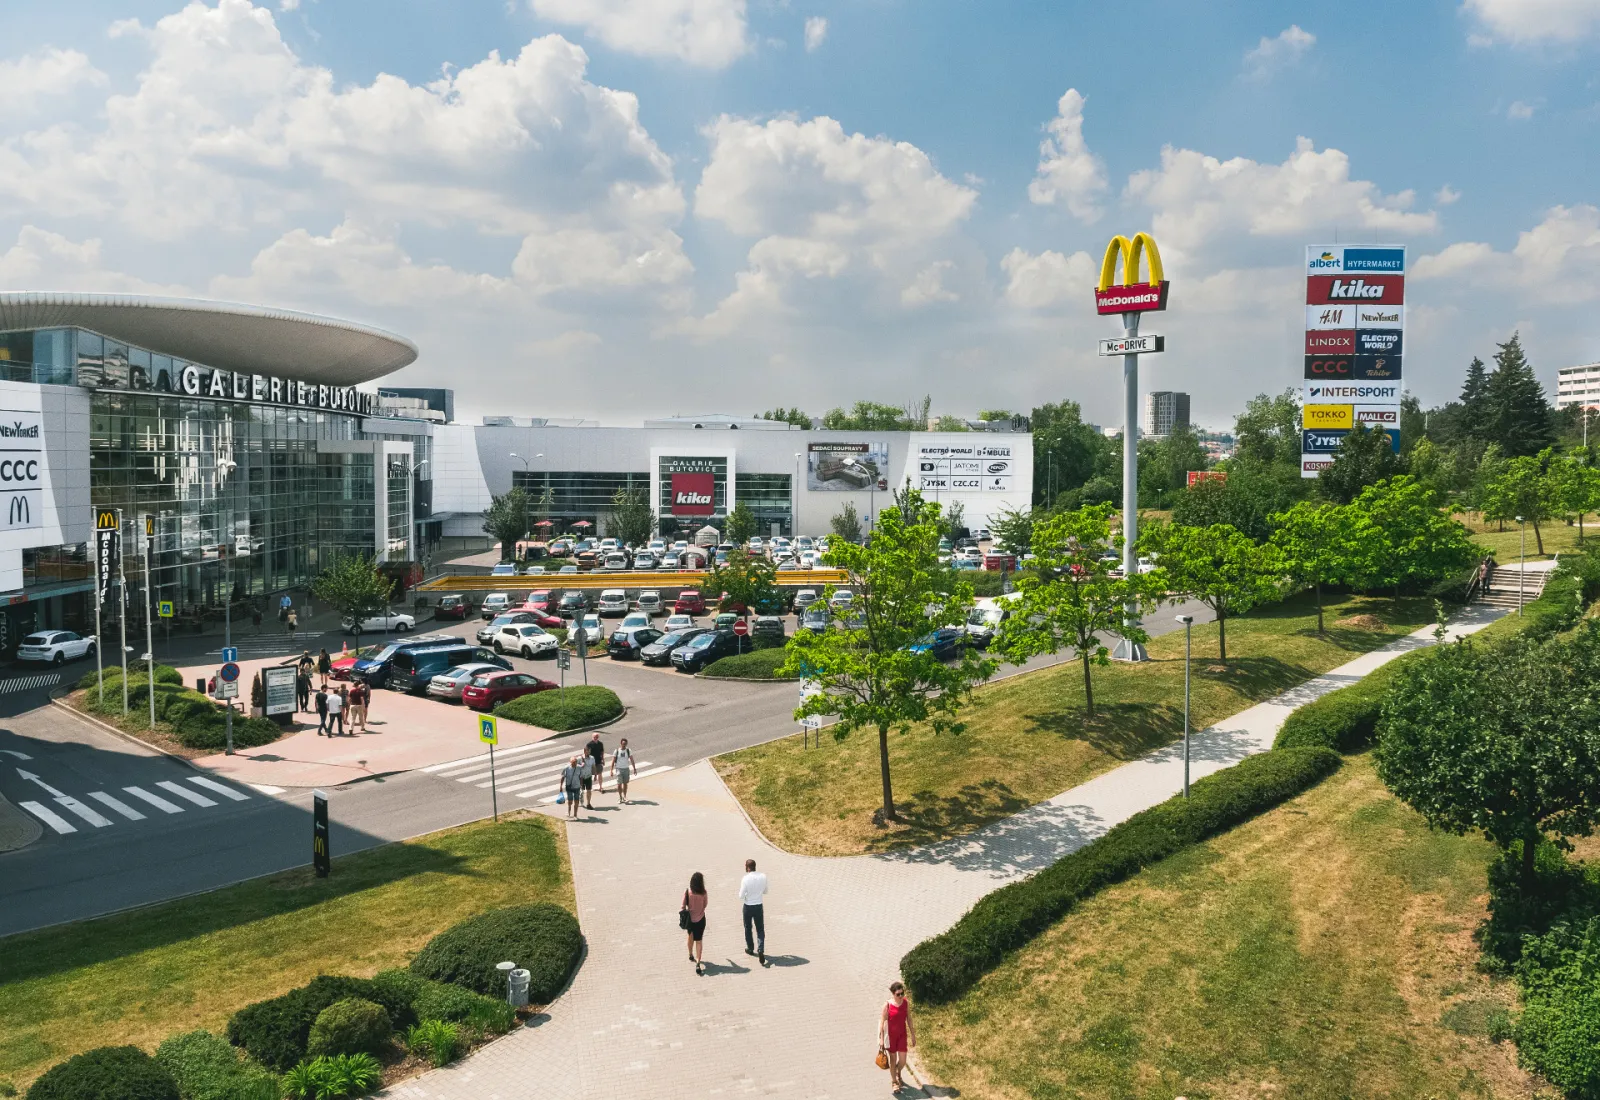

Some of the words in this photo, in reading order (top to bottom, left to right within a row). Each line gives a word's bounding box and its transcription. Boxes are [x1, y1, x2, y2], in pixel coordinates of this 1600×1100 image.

[1310, 259, 1341, 268] albert
[1347, 260, 1401, 268] HYPERMARKET
[1331, 280, 1385, 298] kika
[1098, 293, 1159, 307] McDonald's
[1319, 309, 1343, 325] H&M
[1309, 338, 1350, 346] LINDEX
[1361, 334, 1398, 342] ELECTRO
[1124, 339, 1147, 351] DRIVE
[1311, 361, 1348, 373] CCC
[1366, 369, 1392, 377] Tchibo
[182, 365, 305, 404] GALERIE
[320, 384, 371, 414] BUTOVIC
[1321, 387, 1396, 397] INTERSPORT
[1359, 413, 1395, 421] MALL.CZ
[0, 459, 38, 481] CCC
[676, 492, 712, 504] kika
